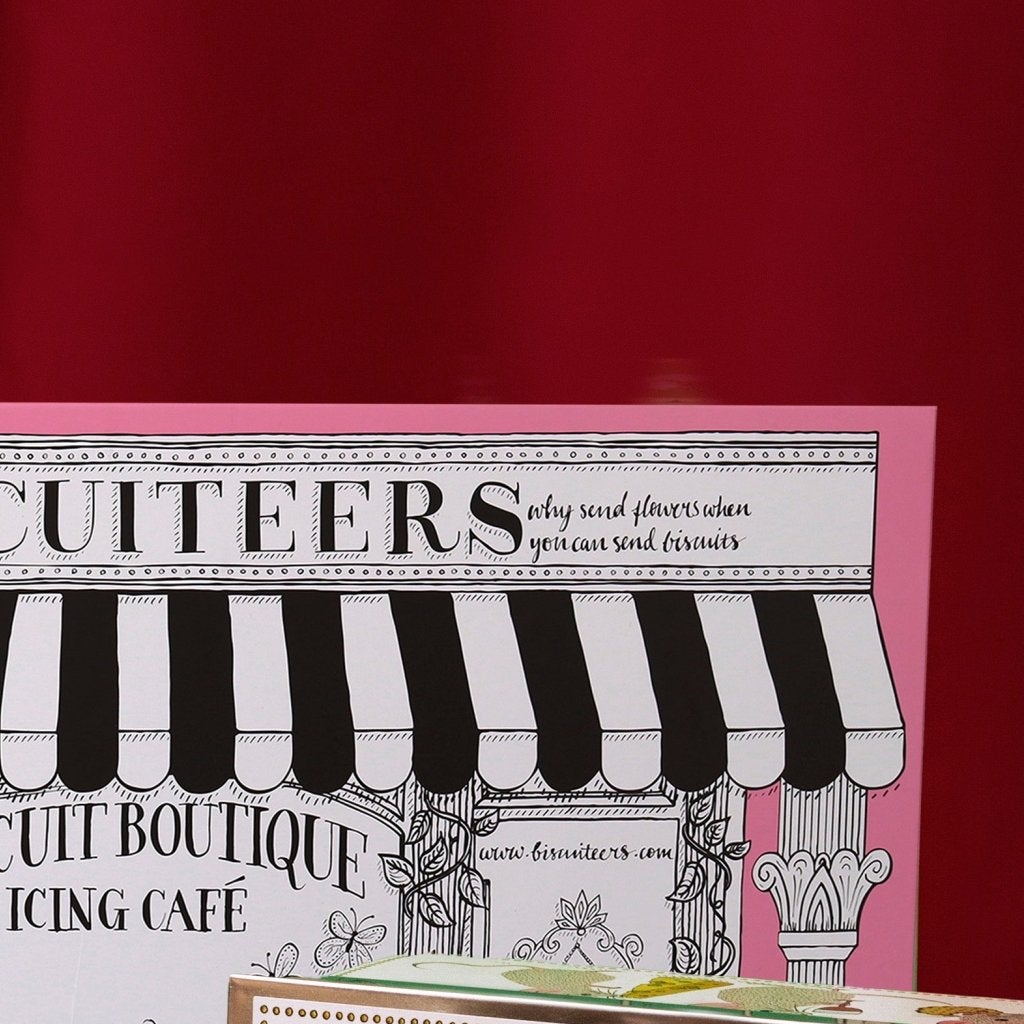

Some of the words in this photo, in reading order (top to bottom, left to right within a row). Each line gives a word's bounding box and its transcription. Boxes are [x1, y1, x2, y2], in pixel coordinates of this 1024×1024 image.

[527, 494, 574, 532] why
[580, 491, 628, 519] send
[632, 494, 699, 527] flowers
[702, 496, 752, 518] when
[530, 535, 571, 563] you
[571, 535, 608, 552] can
[613, 527, 657, 552] send
[662, 528, 746, 553] biscuits
[115, 801, 367, 899] BOUTIQUE
[479, 841, 674, 862] www.biscuiteers.com
[6, 886, 129, 932] ICING
[142, 875, 247, 932] CAFÉ
